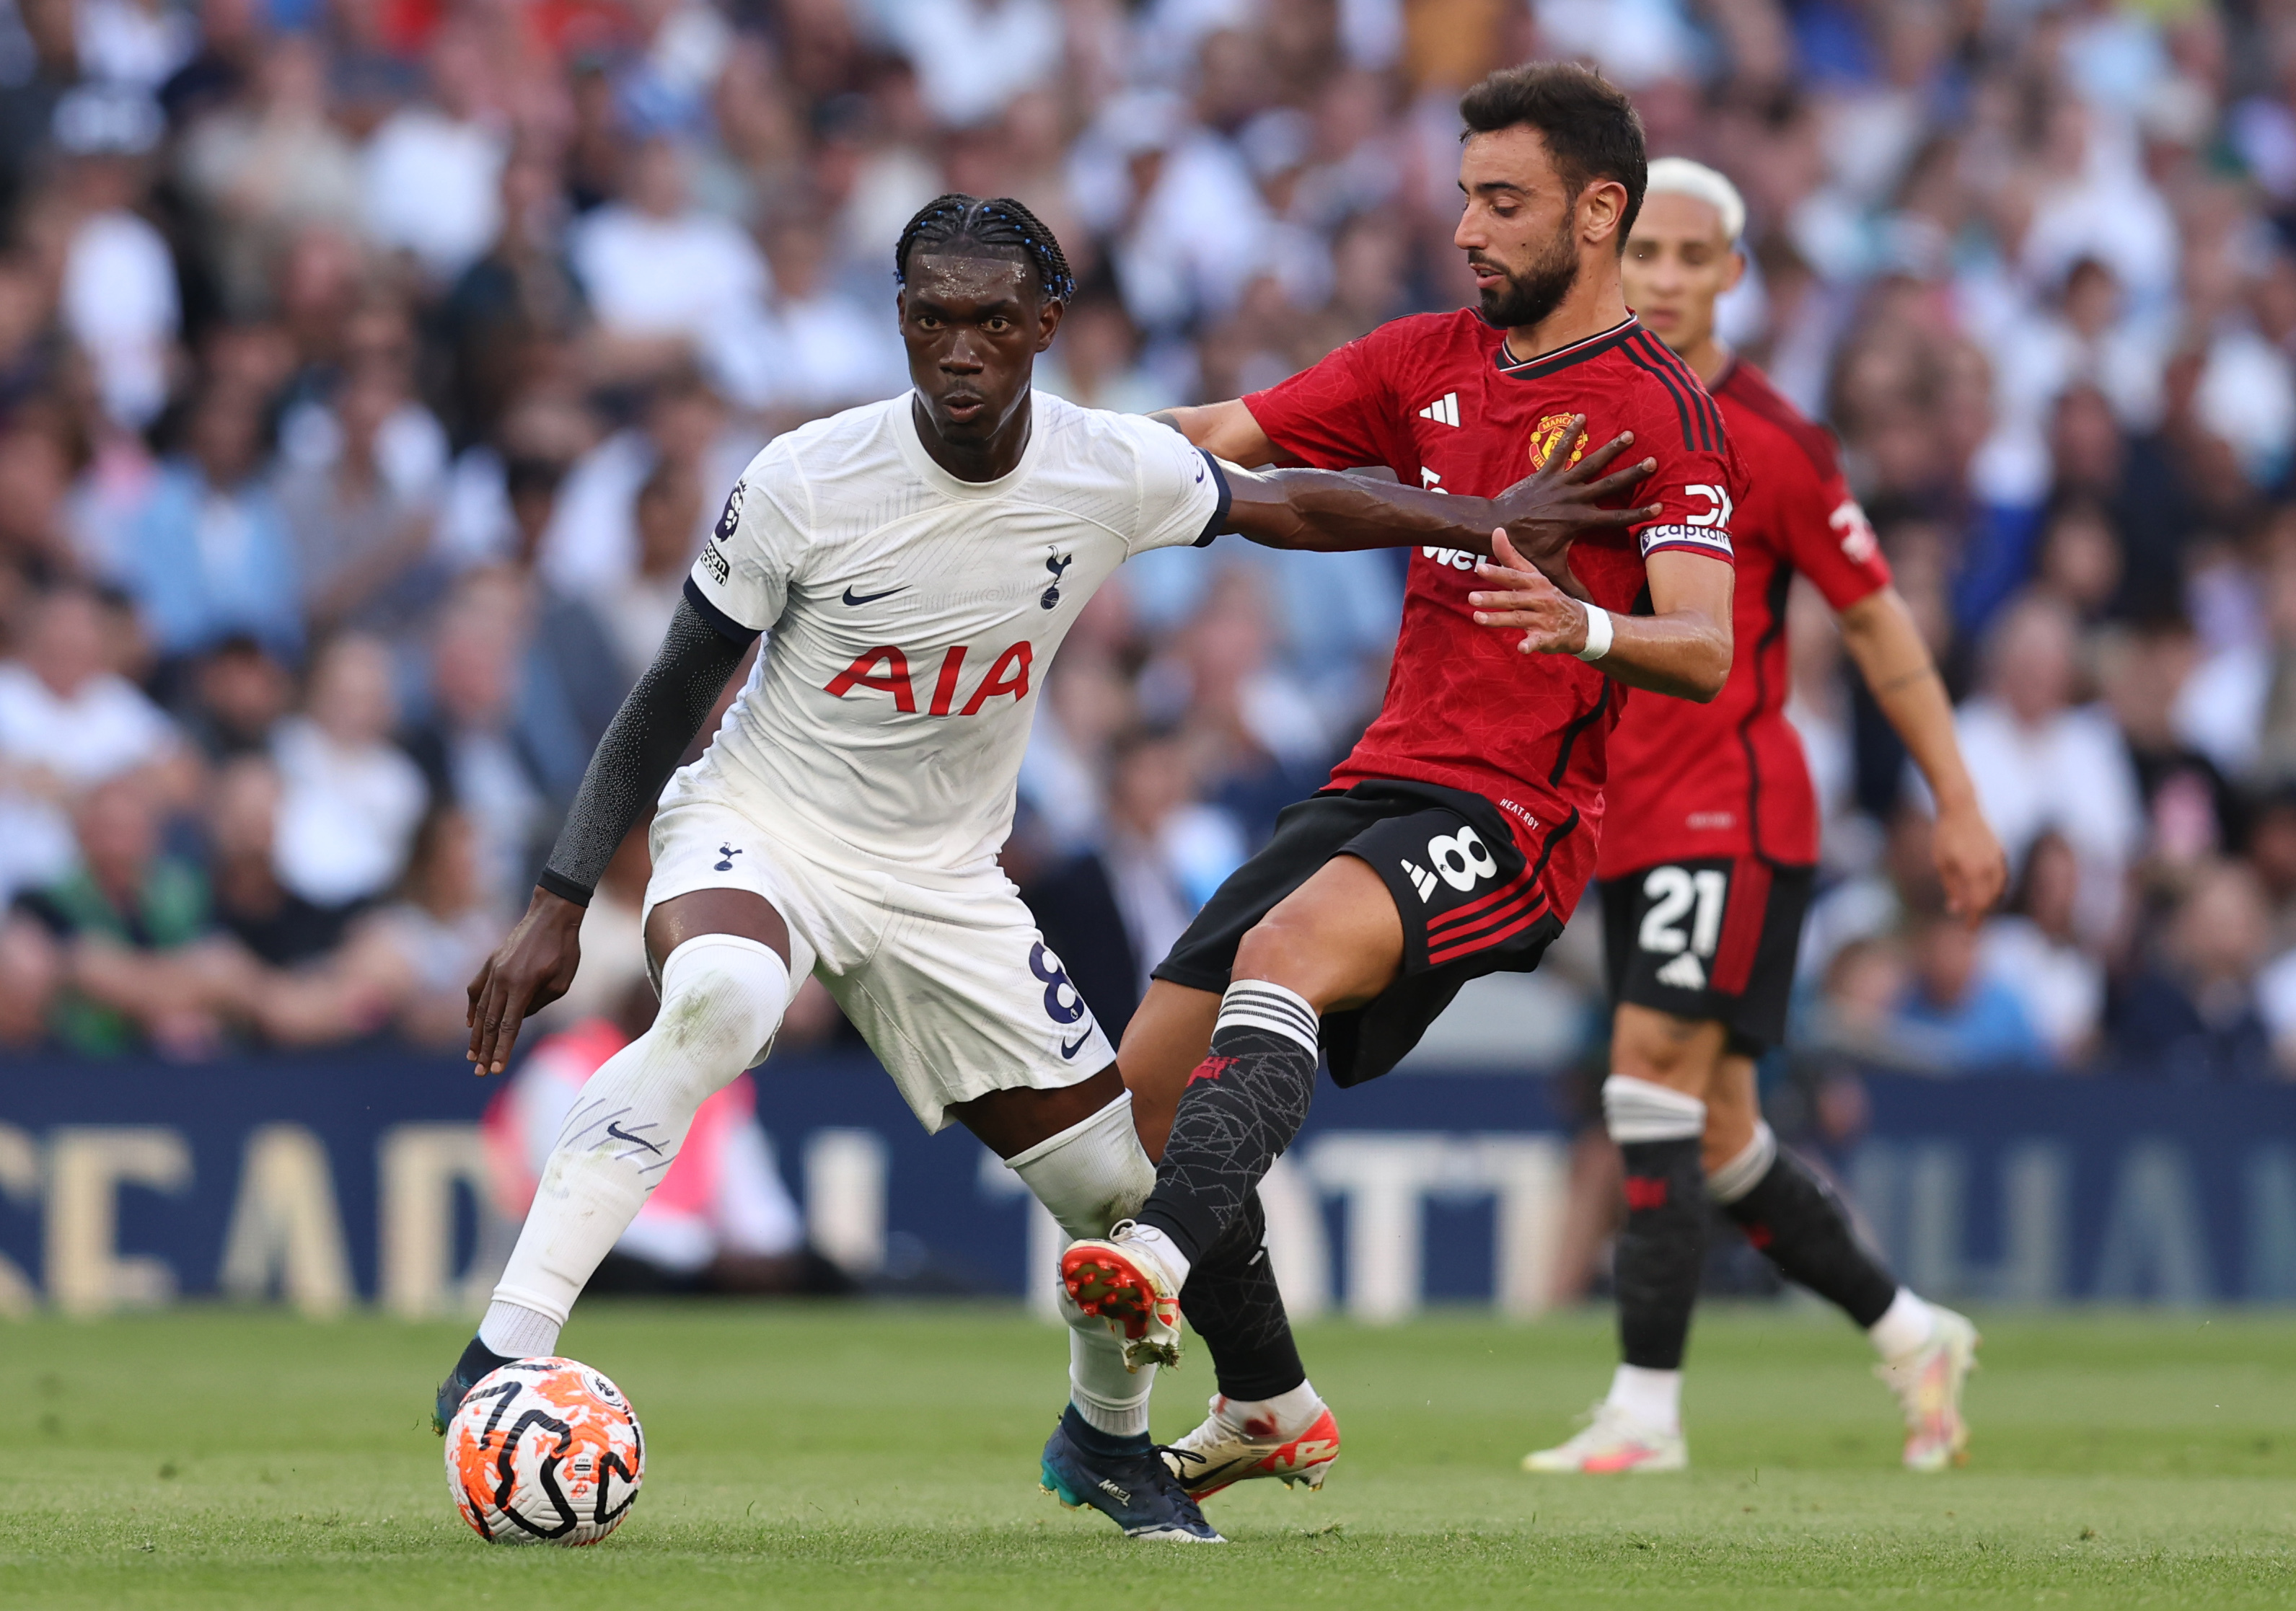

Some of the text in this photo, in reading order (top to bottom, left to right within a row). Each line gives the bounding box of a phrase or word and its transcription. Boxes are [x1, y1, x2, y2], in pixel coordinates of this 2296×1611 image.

[823, 640, 1033, 716] AIA
[1428, 826, 1497, 892] 8
[1638, 865, 1727, 958] 21
[1029, 940, 1085, 1024] 8
